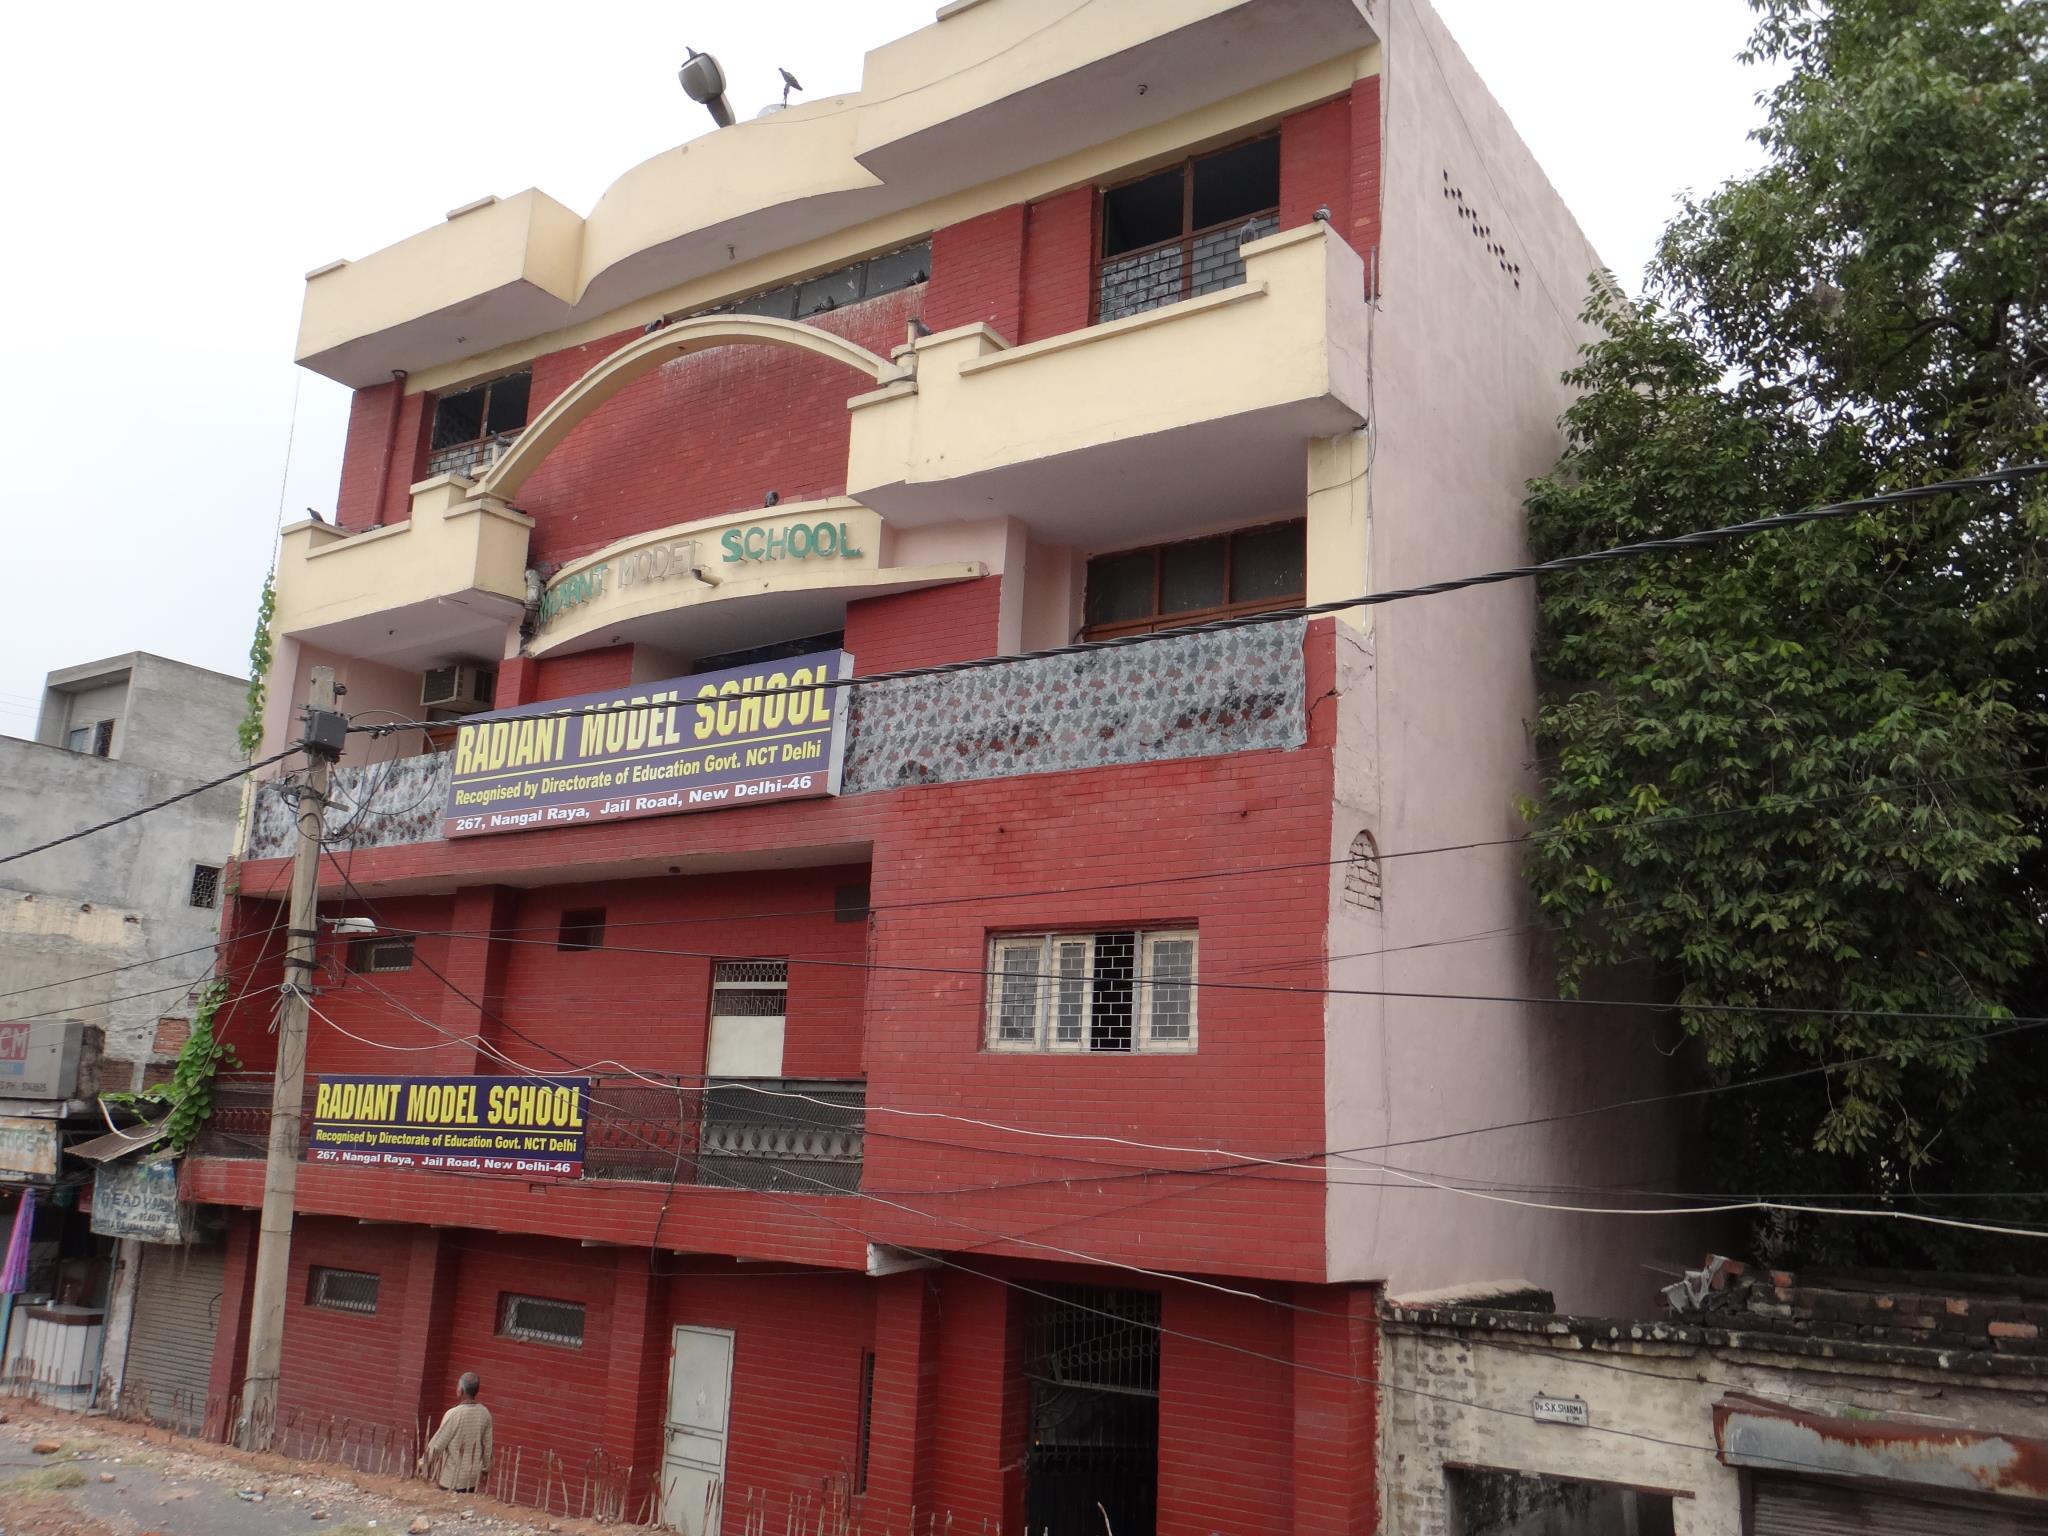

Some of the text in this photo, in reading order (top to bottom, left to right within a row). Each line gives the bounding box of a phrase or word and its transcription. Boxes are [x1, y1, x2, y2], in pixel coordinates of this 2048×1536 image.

[720, 522, 863, 562] SCHOOL
[455, 665, 831, 776] RADIANT MODEL SCHOOL
[455, 740, 822, 806] Recognised by Directorate of Education Govt. NCT Delhi
[455, 775, 812, 831] 267, Nangal Raya, Jail Road, New Delhi-46
[315, 1083, 583, 1127] RADIANT MODEL SCHOOL
[316, 1129, 576, 1152] Recognised by Directorate of Education Govt. NCT Delhi
[317, 1150, 571, 1172] 267, Nangal Raya, Jail Road, New Delhi-46
